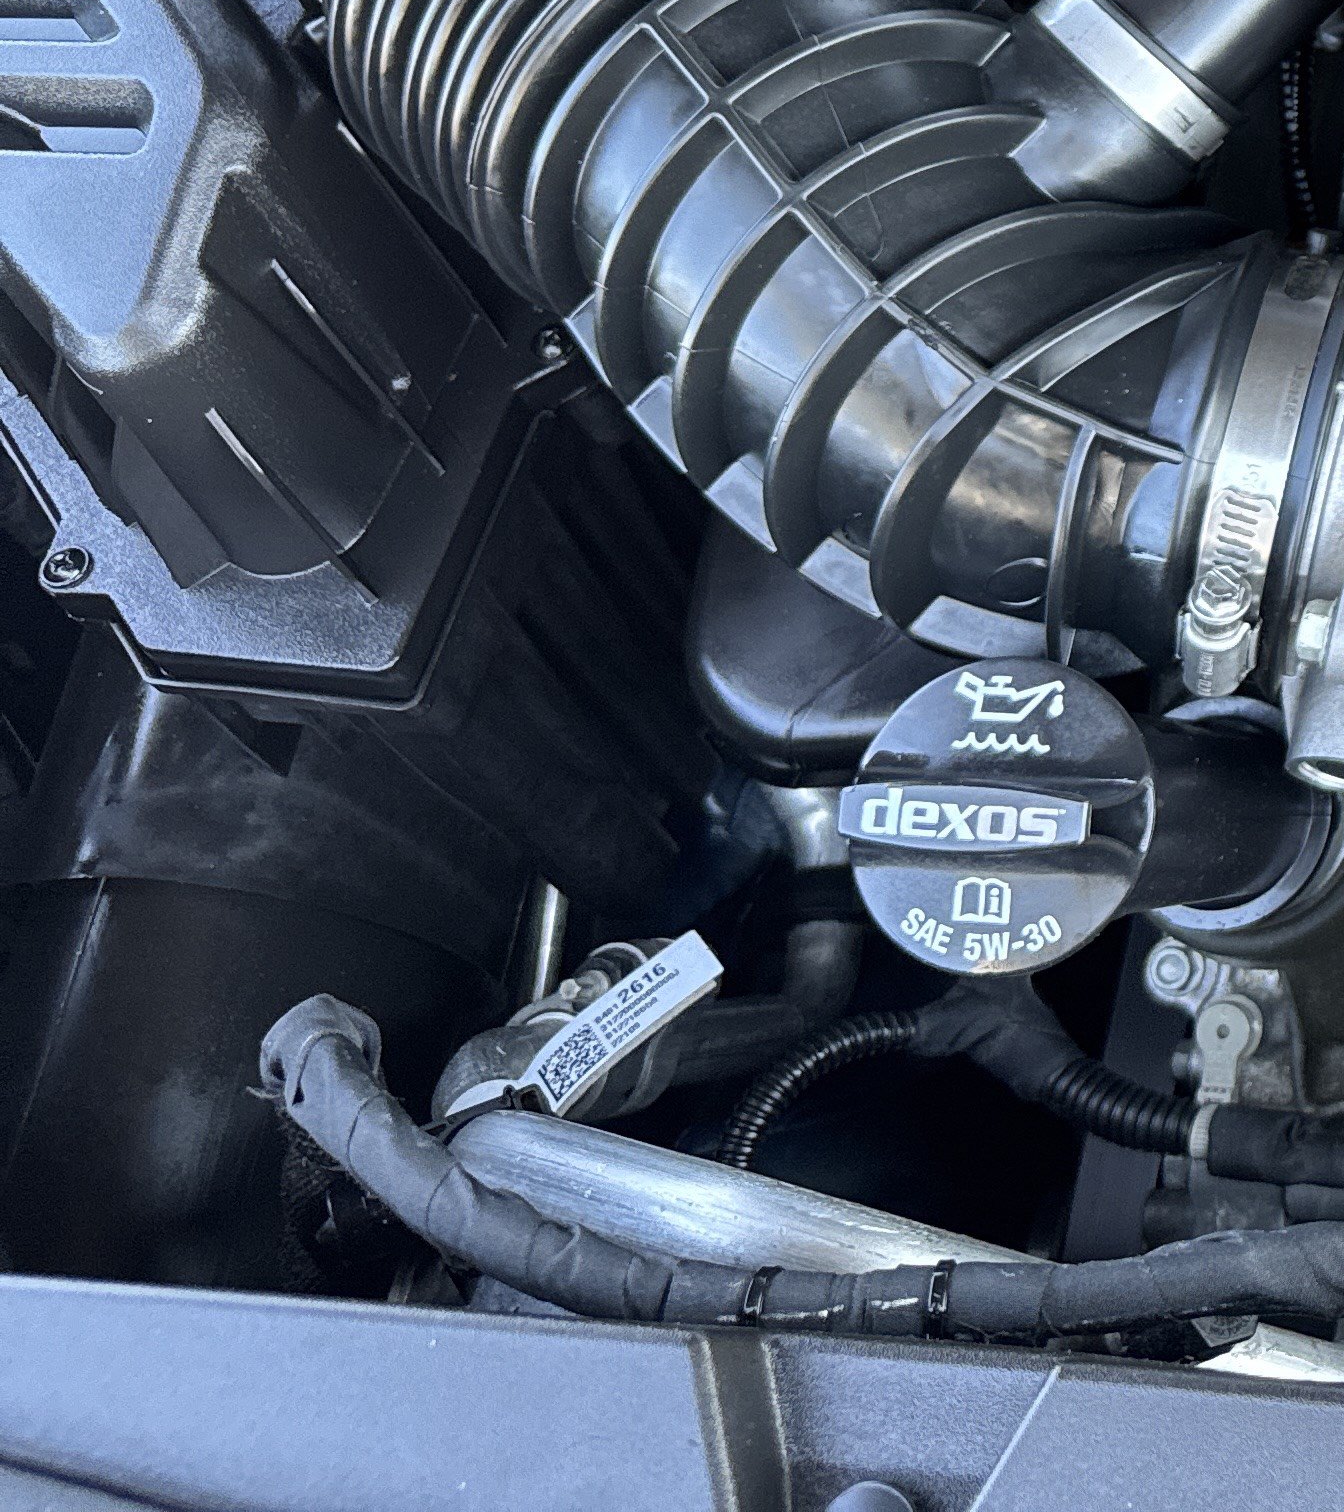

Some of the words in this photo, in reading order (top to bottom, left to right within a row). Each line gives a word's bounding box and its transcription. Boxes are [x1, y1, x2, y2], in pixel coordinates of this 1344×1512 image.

[861, 787, 1059, 844] dexos
[900, 906, 954, 955] SAE
[962, 914, 1063, 962] 5W-30
[617, 962, 666, 1004] 2616
